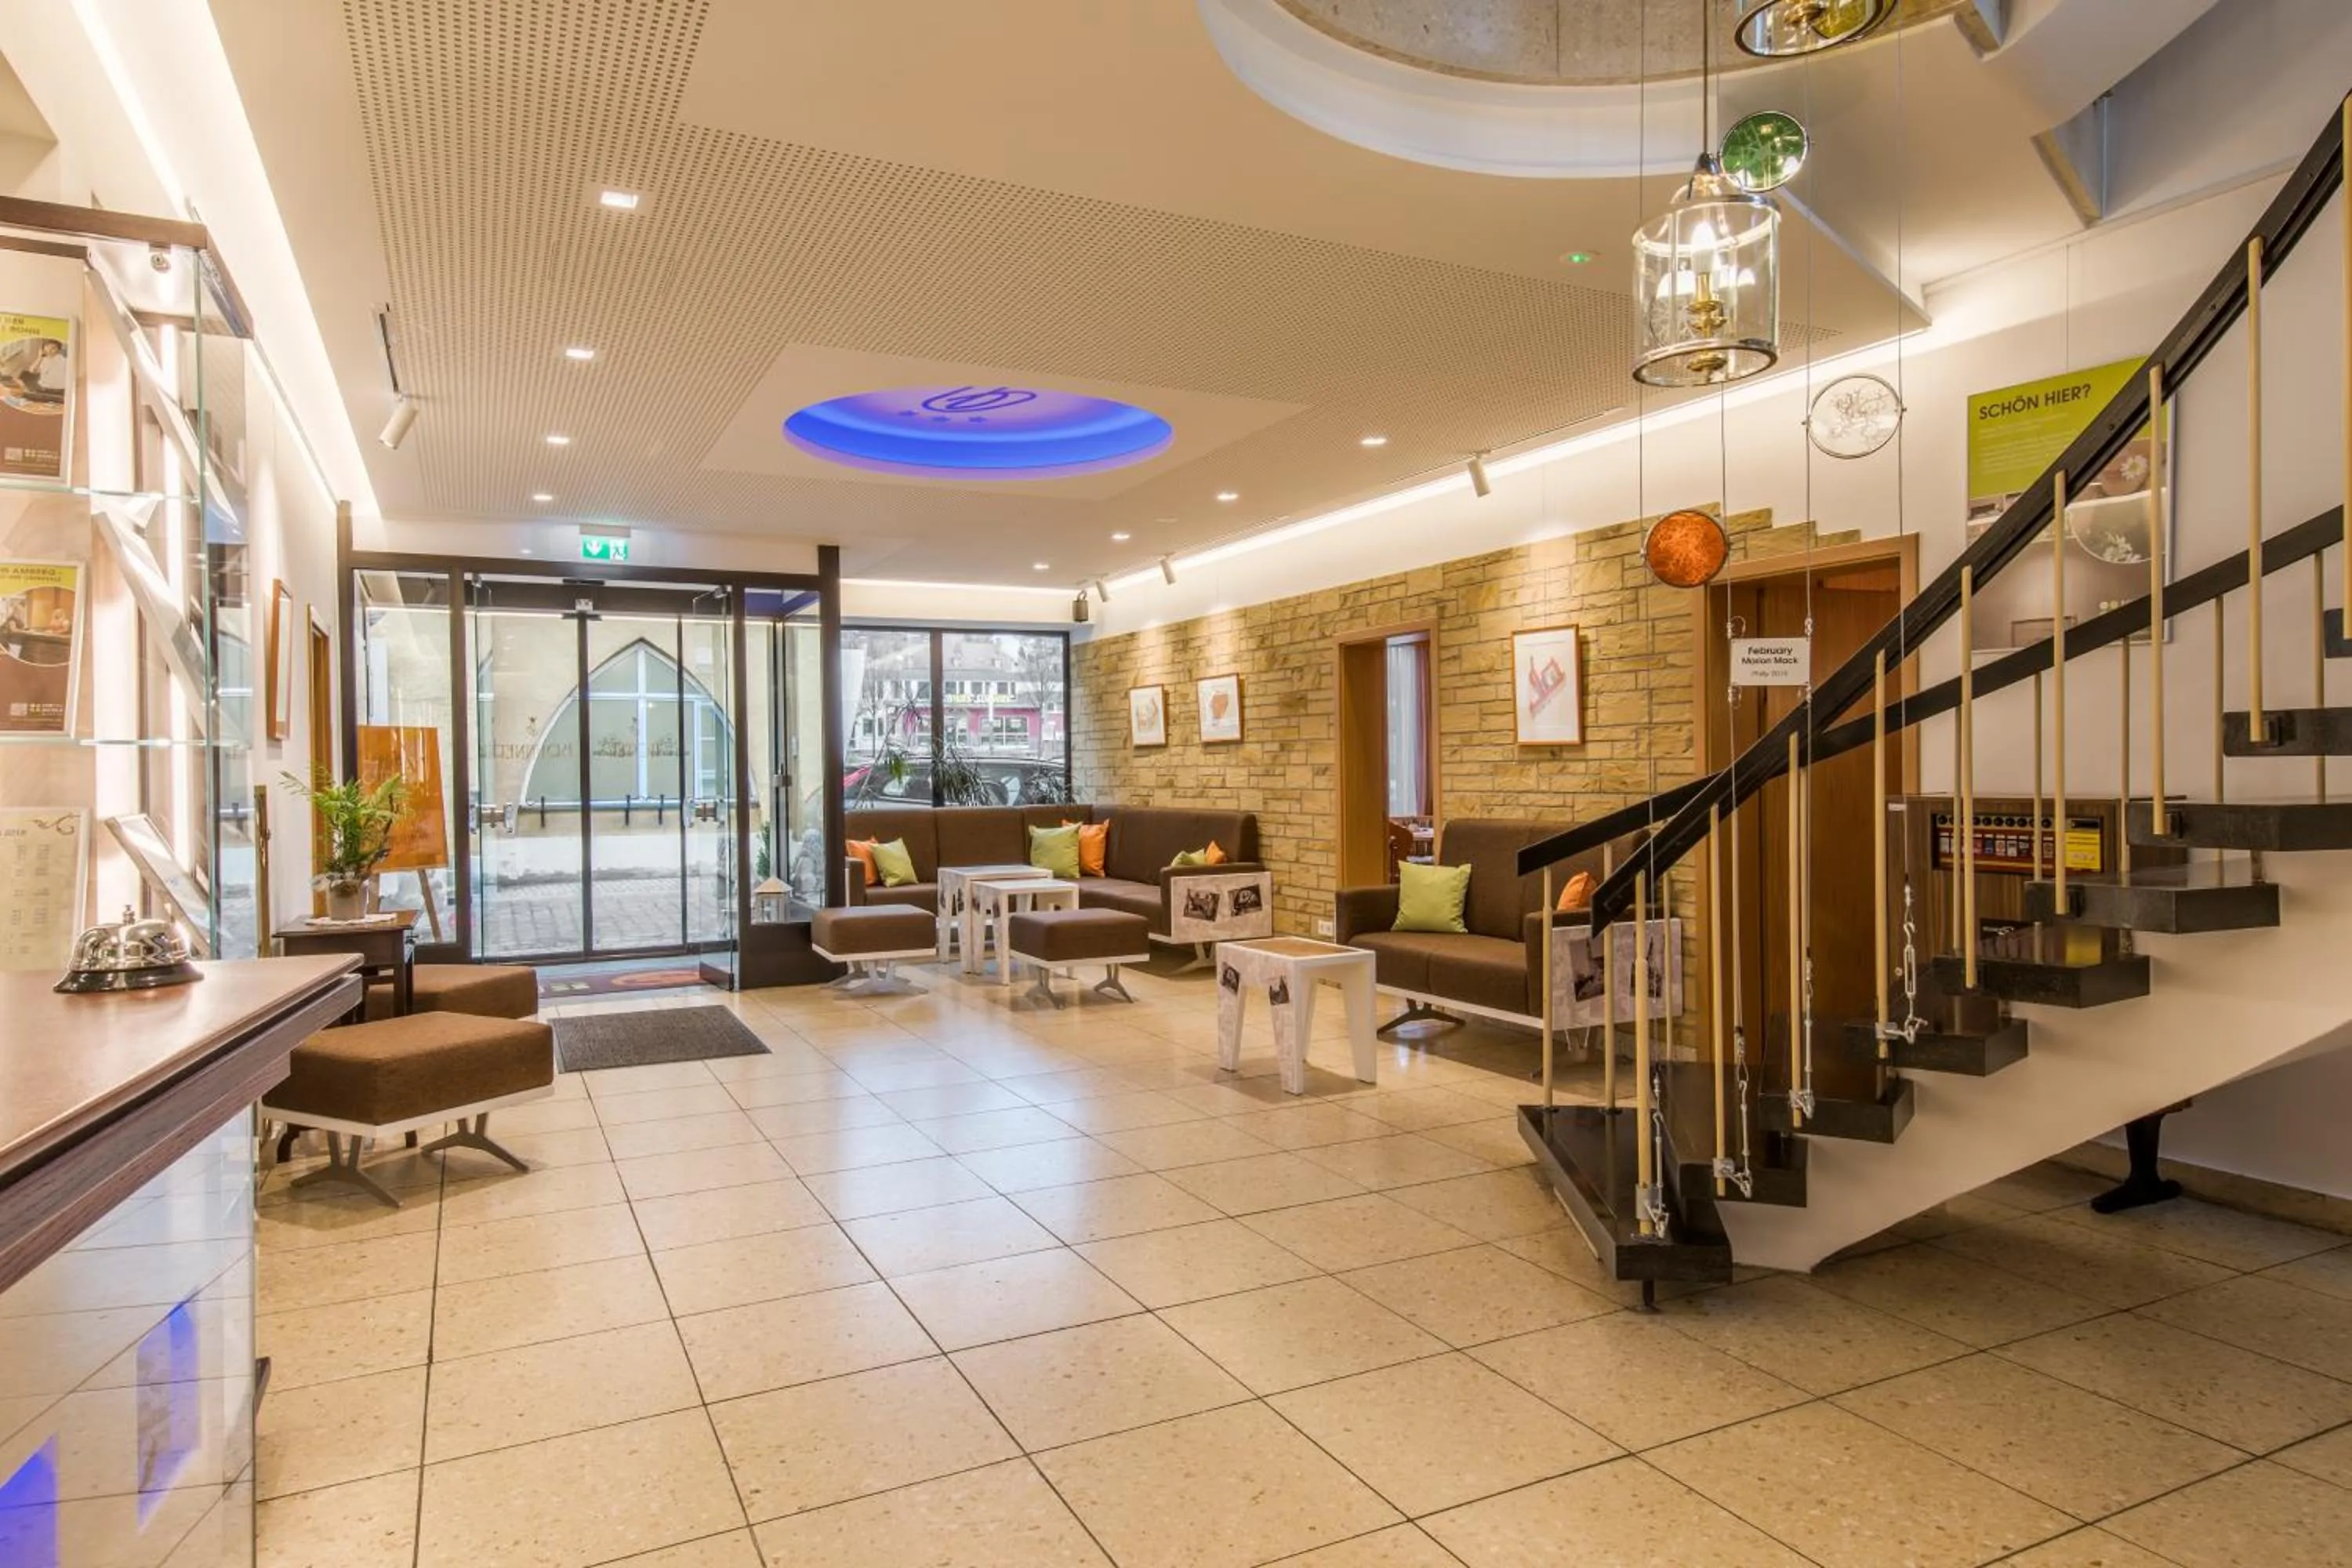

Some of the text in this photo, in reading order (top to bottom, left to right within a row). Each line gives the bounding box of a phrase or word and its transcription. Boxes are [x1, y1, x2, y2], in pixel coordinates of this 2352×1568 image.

[1979, 383, 2092, 420] SCHÖN HIER?
[1748, 646, 1793, 655] February
[1773, 656, 1798, 665] Mack
